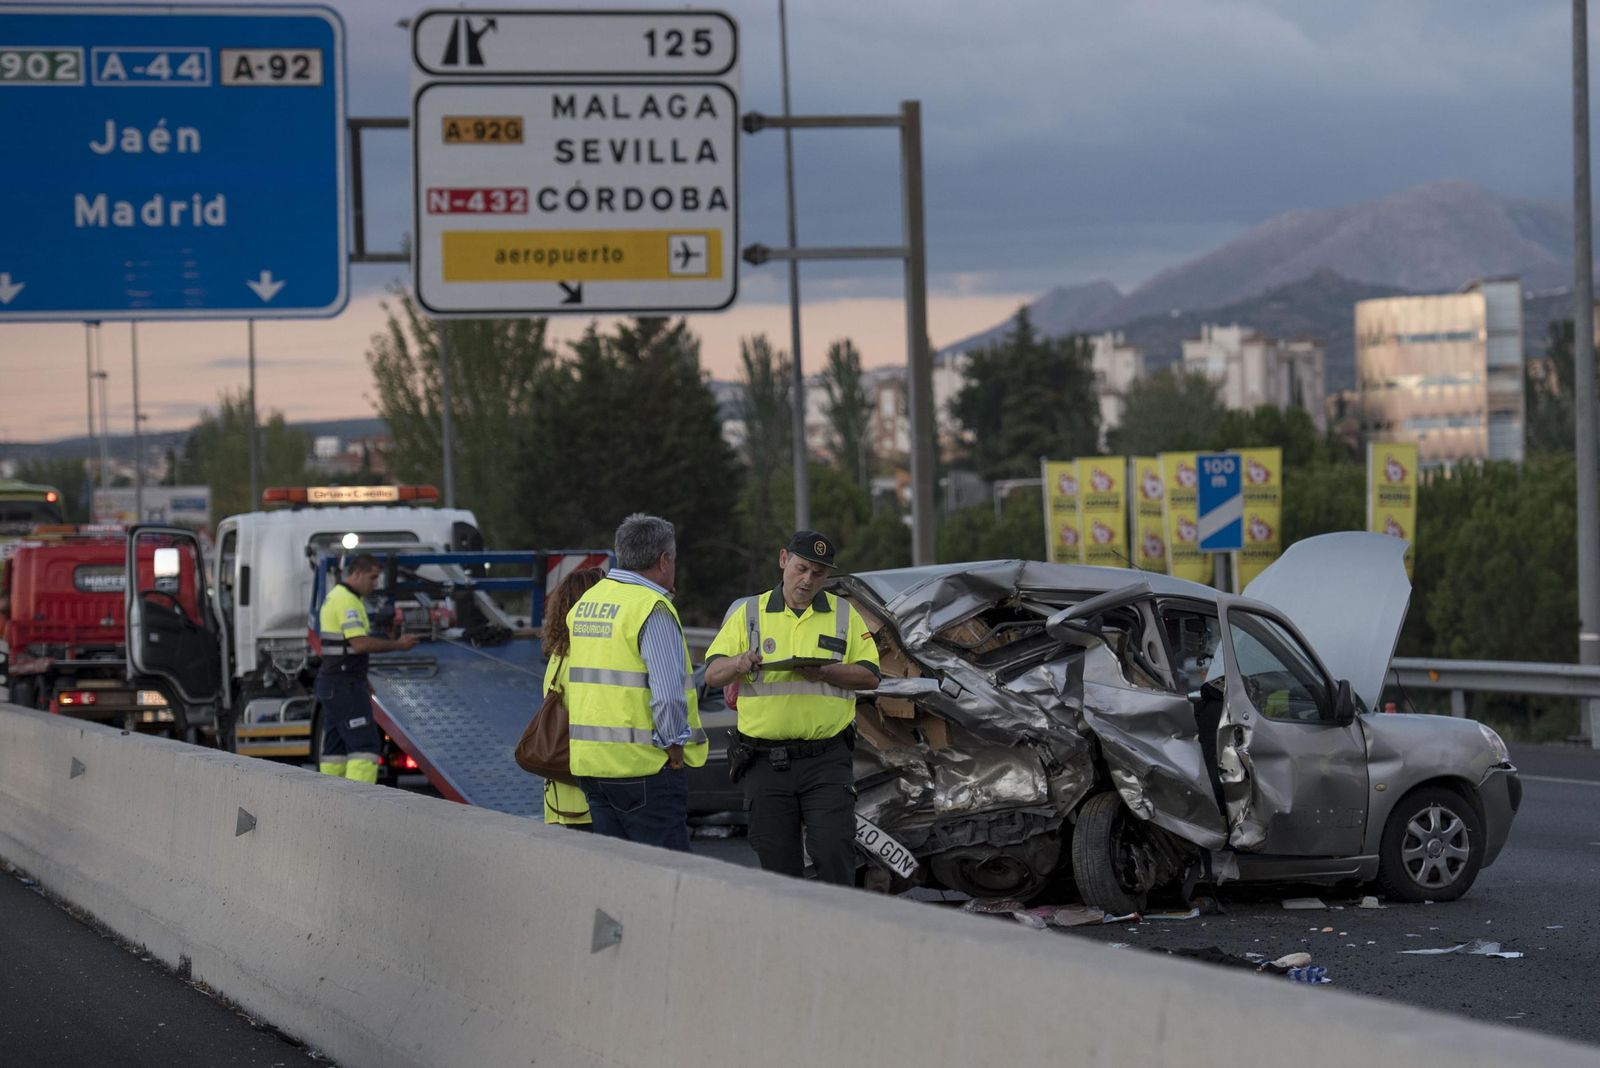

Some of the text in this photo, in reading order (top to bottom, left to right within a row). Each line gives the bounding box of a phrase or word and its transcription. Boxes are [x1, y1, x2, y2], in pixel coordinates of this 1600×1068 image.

[644, 28, 713, 58] 125
[1, 53, 78, 79] 902
[101, 53, 204, 80] A-44
[232, 54, 312, 80] A-92
[551, 93, 719, 120] MALAGA
[88, 117, 201, 154] Jaén
[444, 121, 522, 140] A-92G
[553, 138, 719, 165] SEVILLA
[428, 190, 526, 214] N-432
[535, 180, 729, 213] CÓRDOBA
[73, 193, 227, 228] Madrid
[493, 245, 625, 267] aeropuerto
[1203, 458, 1236, 475] 100
[1211, 475, 1228, 489] m
[575, 601, 621, 620] EULEN
[574, 623, 611, 634] SEGURIDAD
[856, 819, 914, 873] 40 GDN
